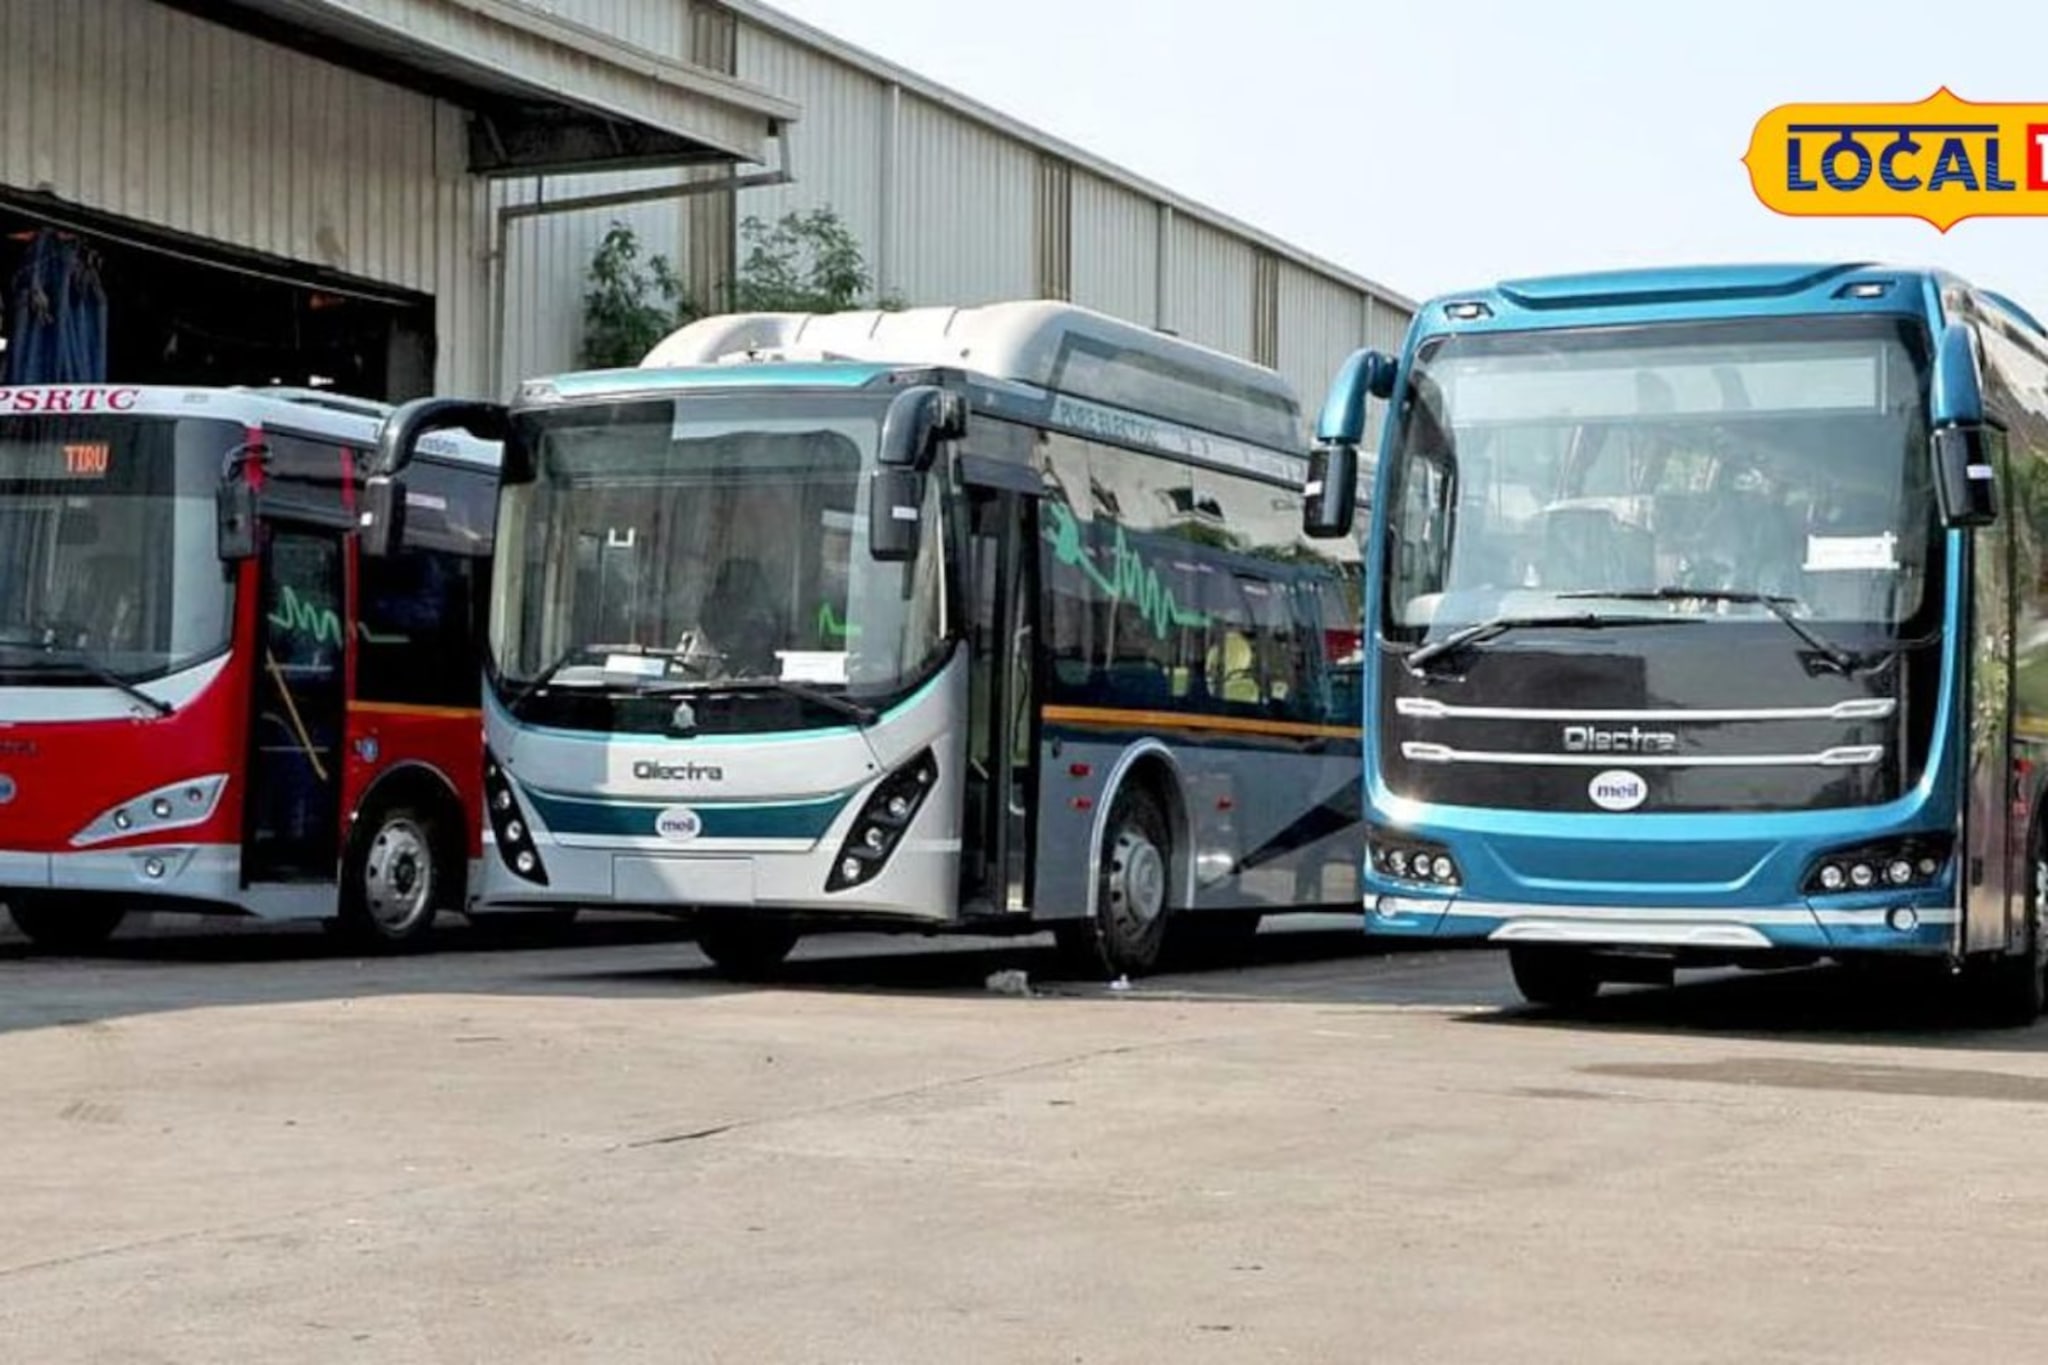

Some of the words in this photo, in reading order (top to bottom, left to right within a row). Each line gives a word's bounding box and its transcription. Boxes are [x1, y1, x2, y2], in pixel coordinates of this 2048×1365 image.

[1564, 726, 1676, 751] Olectra
[633, 761, 722, 780] Olectra
[1598, 783, 1638, 798] meil
